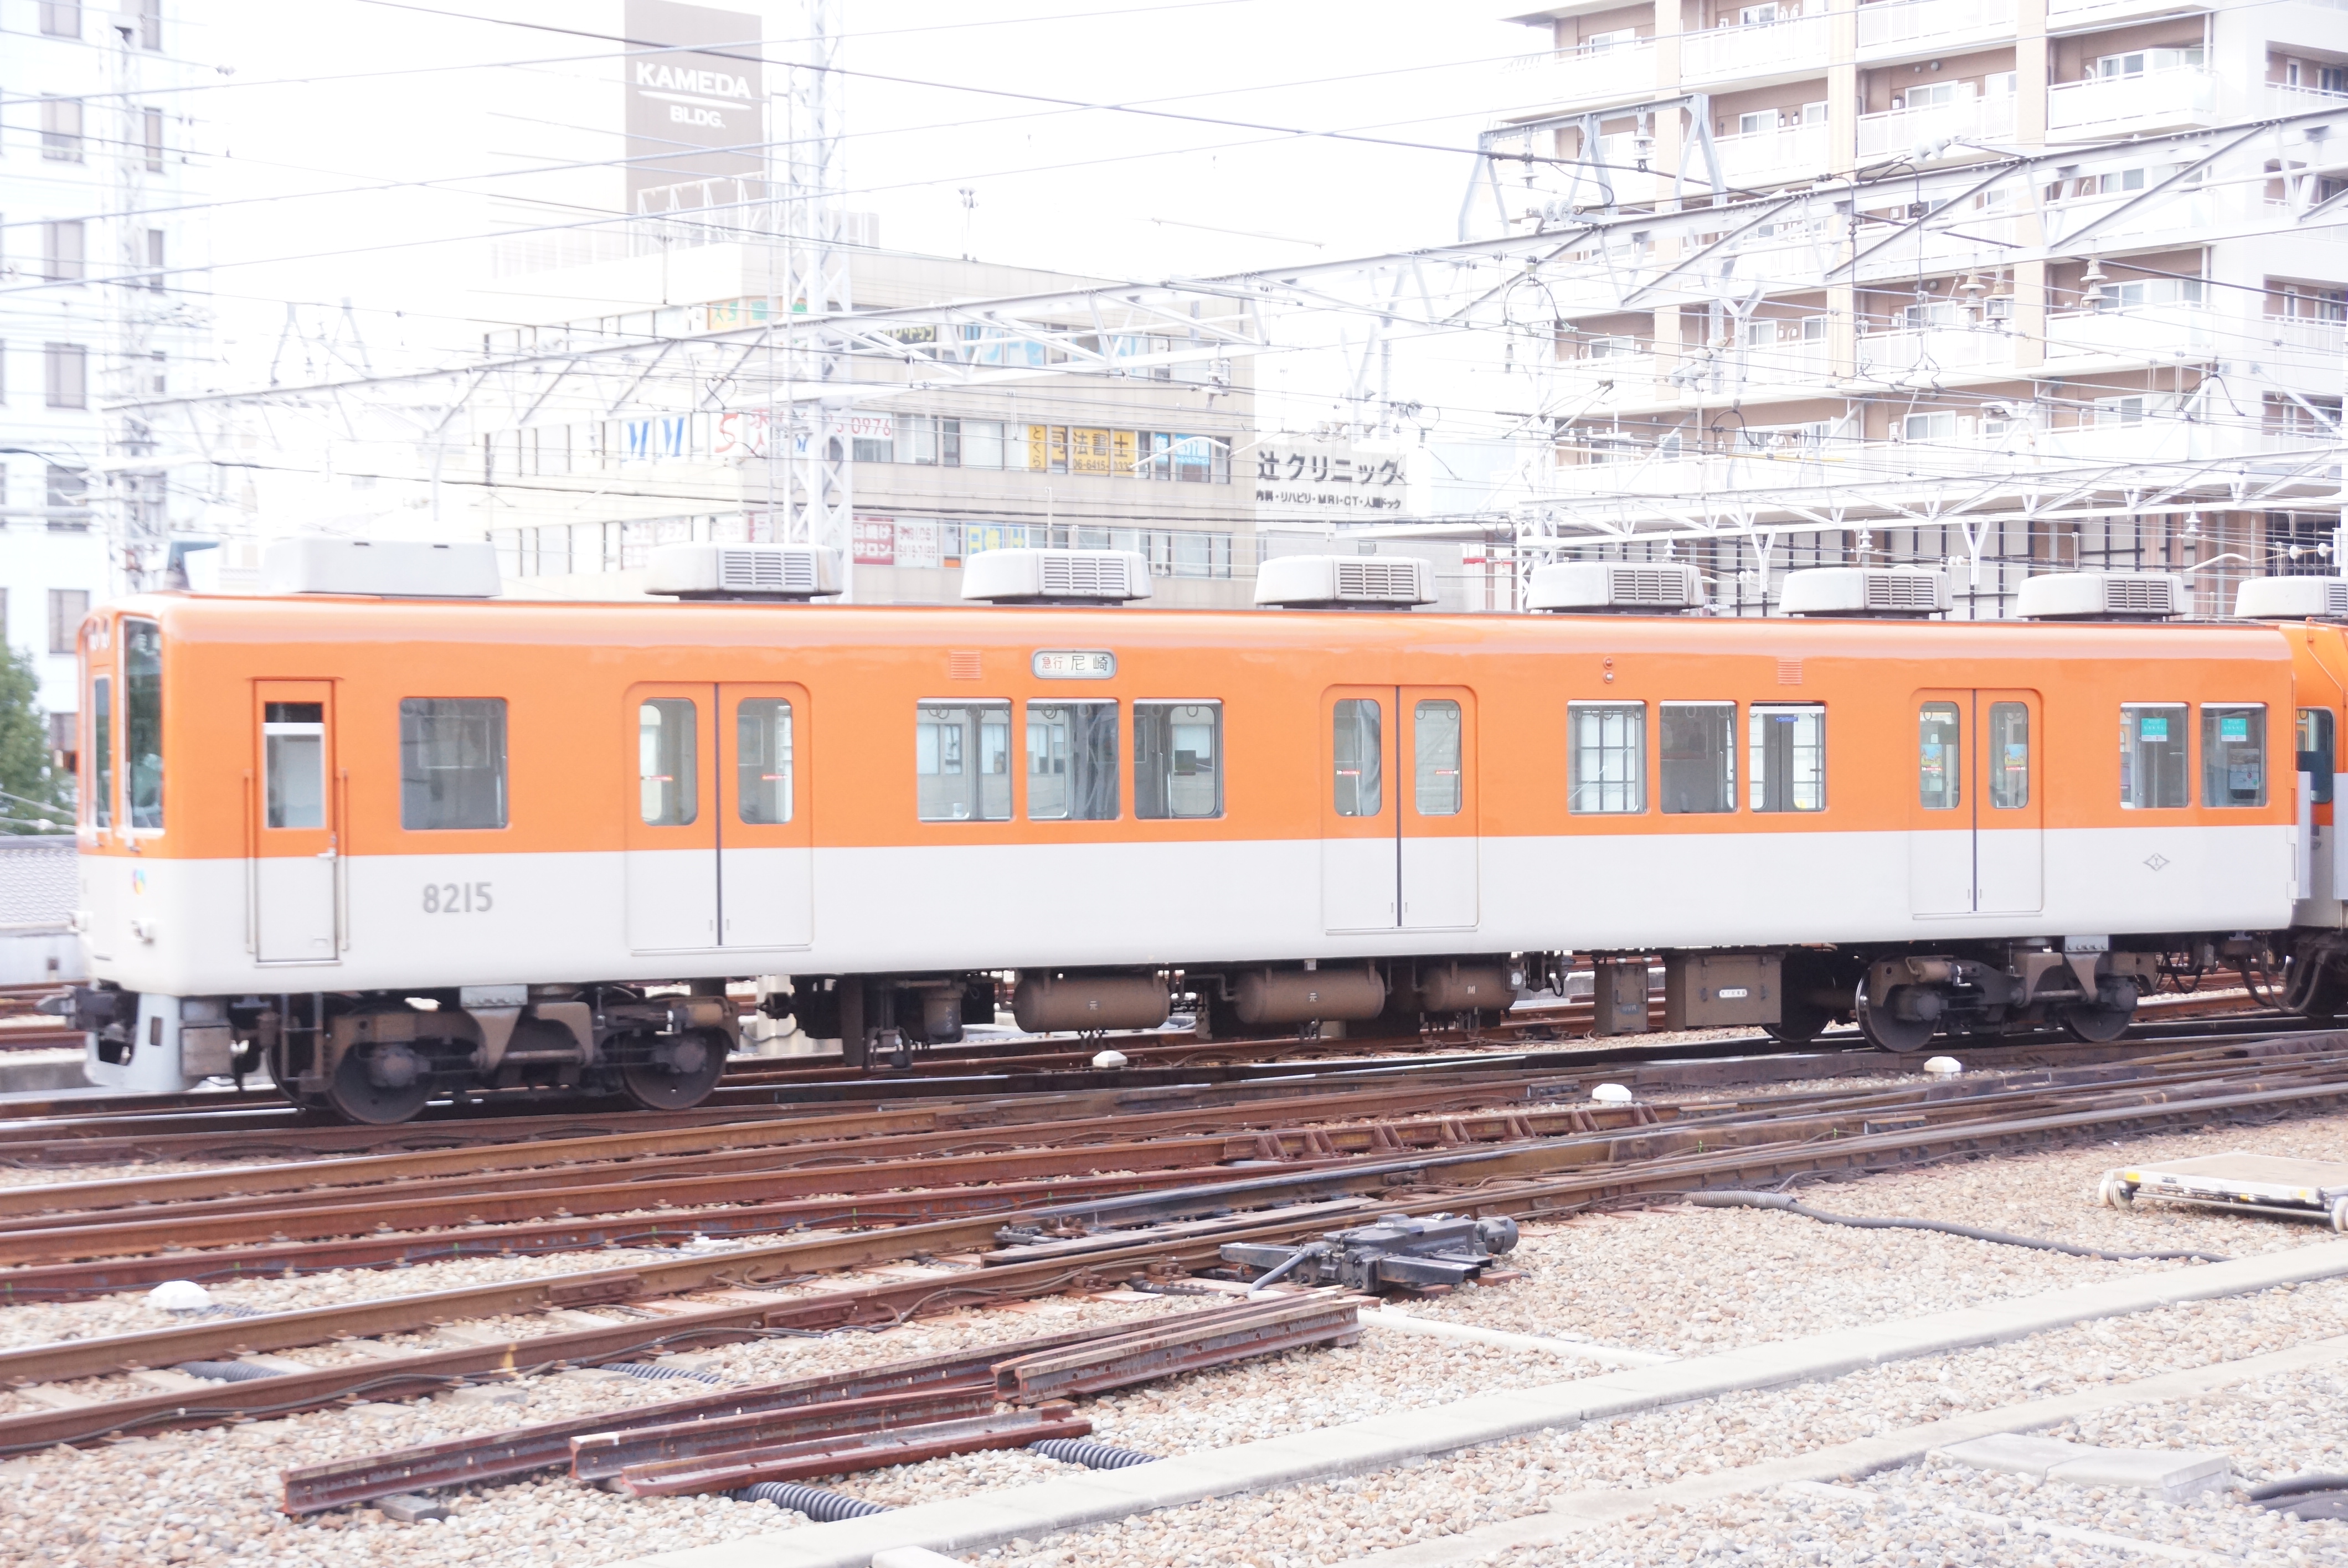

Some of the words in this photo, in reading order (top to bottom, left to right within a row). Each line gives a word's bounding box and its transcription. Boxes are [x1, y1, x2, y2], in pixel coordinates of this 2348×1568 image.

[636, 61, 753, 99] KAMEDA
[670, 105, 726, 128] BLDG.
[1051, 427, 1129, 458] 司法書士
[1258, 450, 1398, 485] 辻クリニック
[1042, 656, 1063, 669] 急行
[1071, 655, 1108, 670] 尼崎
[423, 881, 493, 913] 8215
